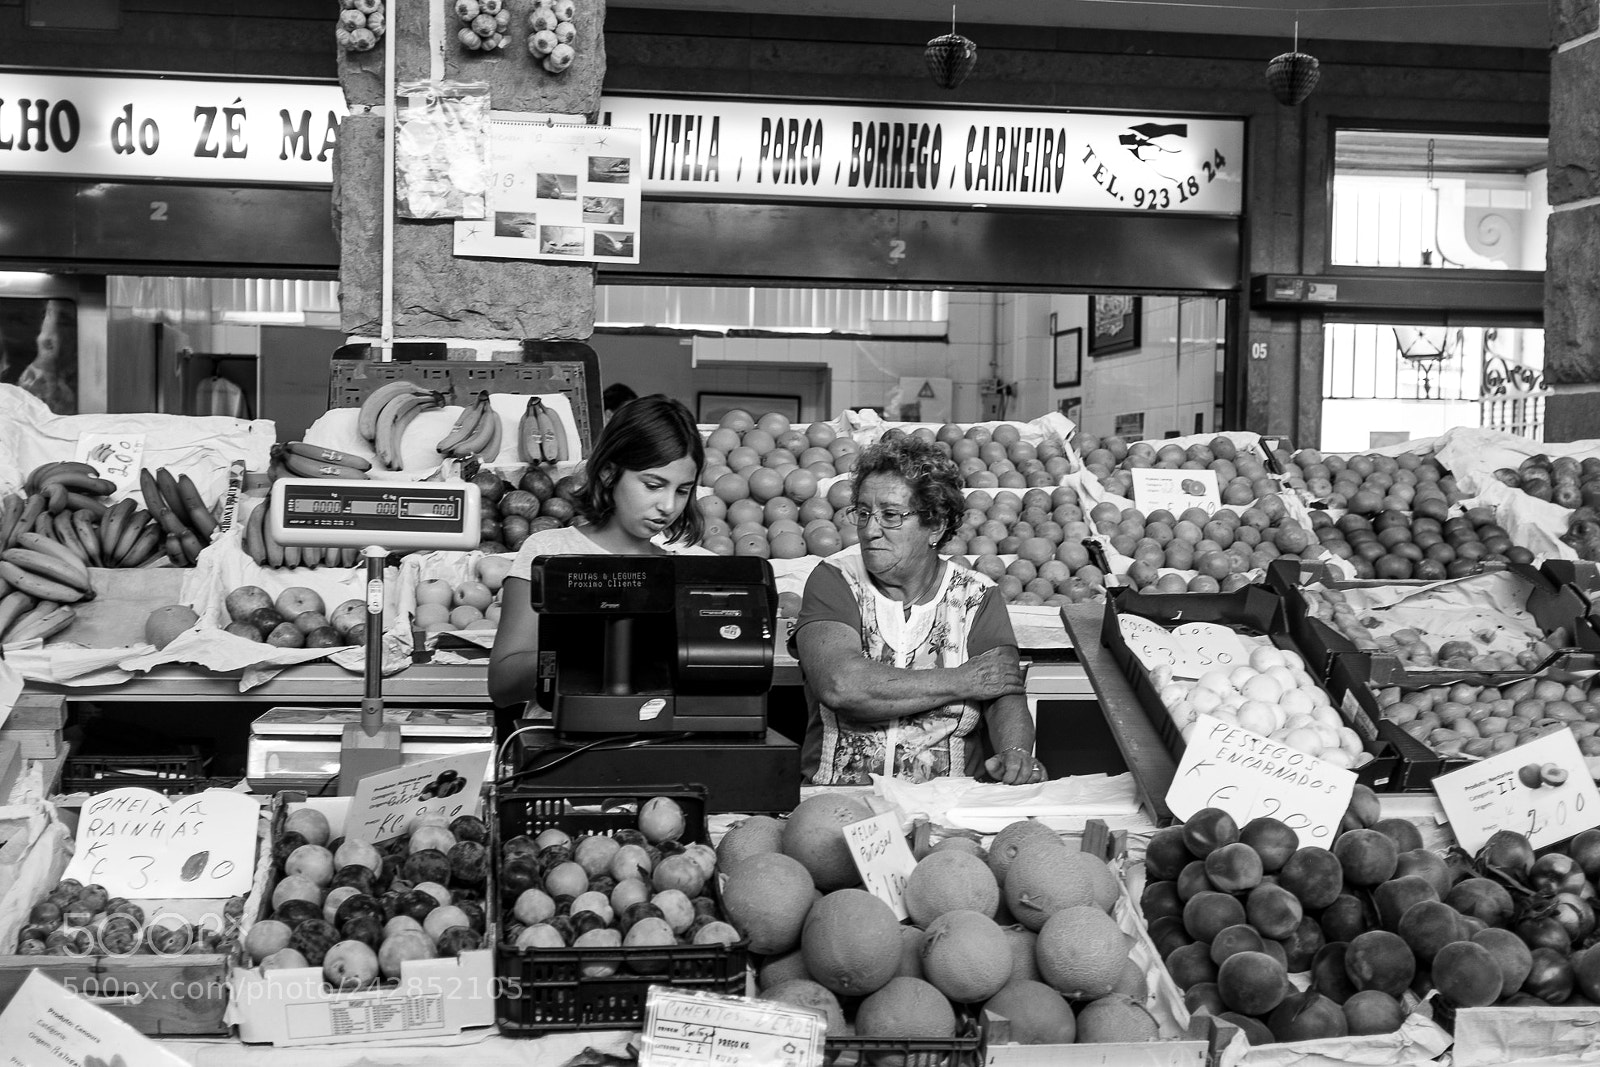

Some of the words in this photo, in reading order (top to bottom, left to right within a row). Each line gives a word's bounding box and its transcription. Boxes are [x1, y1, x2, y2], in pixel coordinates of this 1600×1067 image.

[111, 103, 160, 156] do
[194, 96, 248, 159] ZÉ
[648, 113, 720, 182] VITELA
[757, 116, 823, 185] PORCO
[848, 121, 942, 190] BORREGO
[965, 124, 1066, 194] CARNEIRO
[1082, 144, 1124, 201] TEL.
[1133, 187, 1170, 210] 923
[1177, 175, 1200, 203] 18
[1202, 148, 1226, 183] 24
[150, 201, 168, 221] 2
[889, 240, 906, 259] 2
[1251, 342, 1268, 359] 05
[568, 572, 598, 580] FRUTAS
[612, 572, 647, 580] LEGUMES
[568, 580, 603, 588] Proximo
[607, 579, 642, 588] Cliente
[86, 818, 204, 840] RAINHAS
